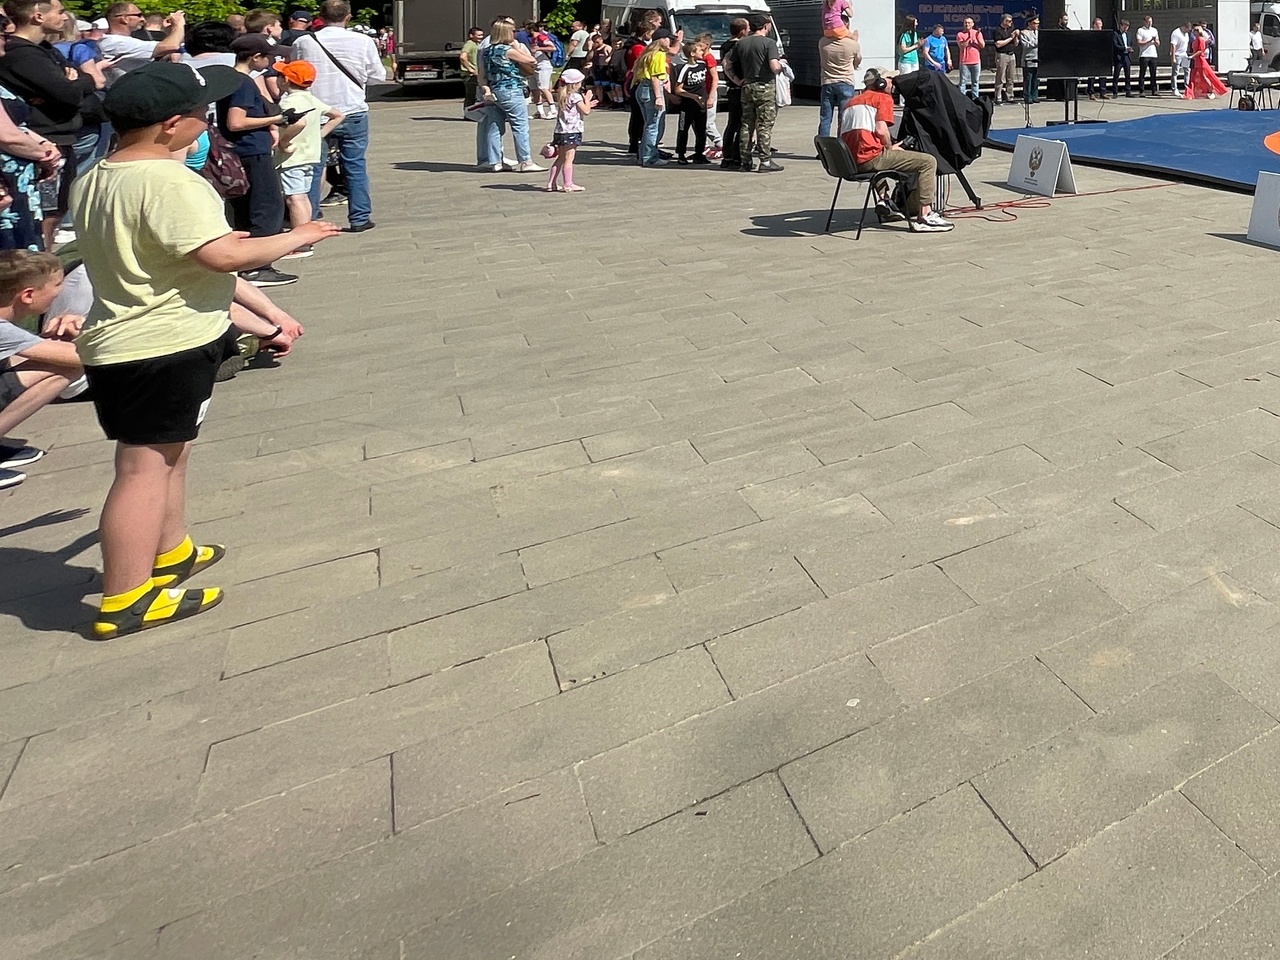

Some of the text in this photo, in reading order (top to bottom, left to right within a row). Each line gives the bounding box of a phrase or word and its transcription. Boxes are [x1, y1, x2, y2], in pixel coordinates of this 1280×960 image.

[918, 4, 933, 14] ПО
[933, 3, 974, 14] ВОЛЬНОЙ
[944, 14, 951, 23] И
